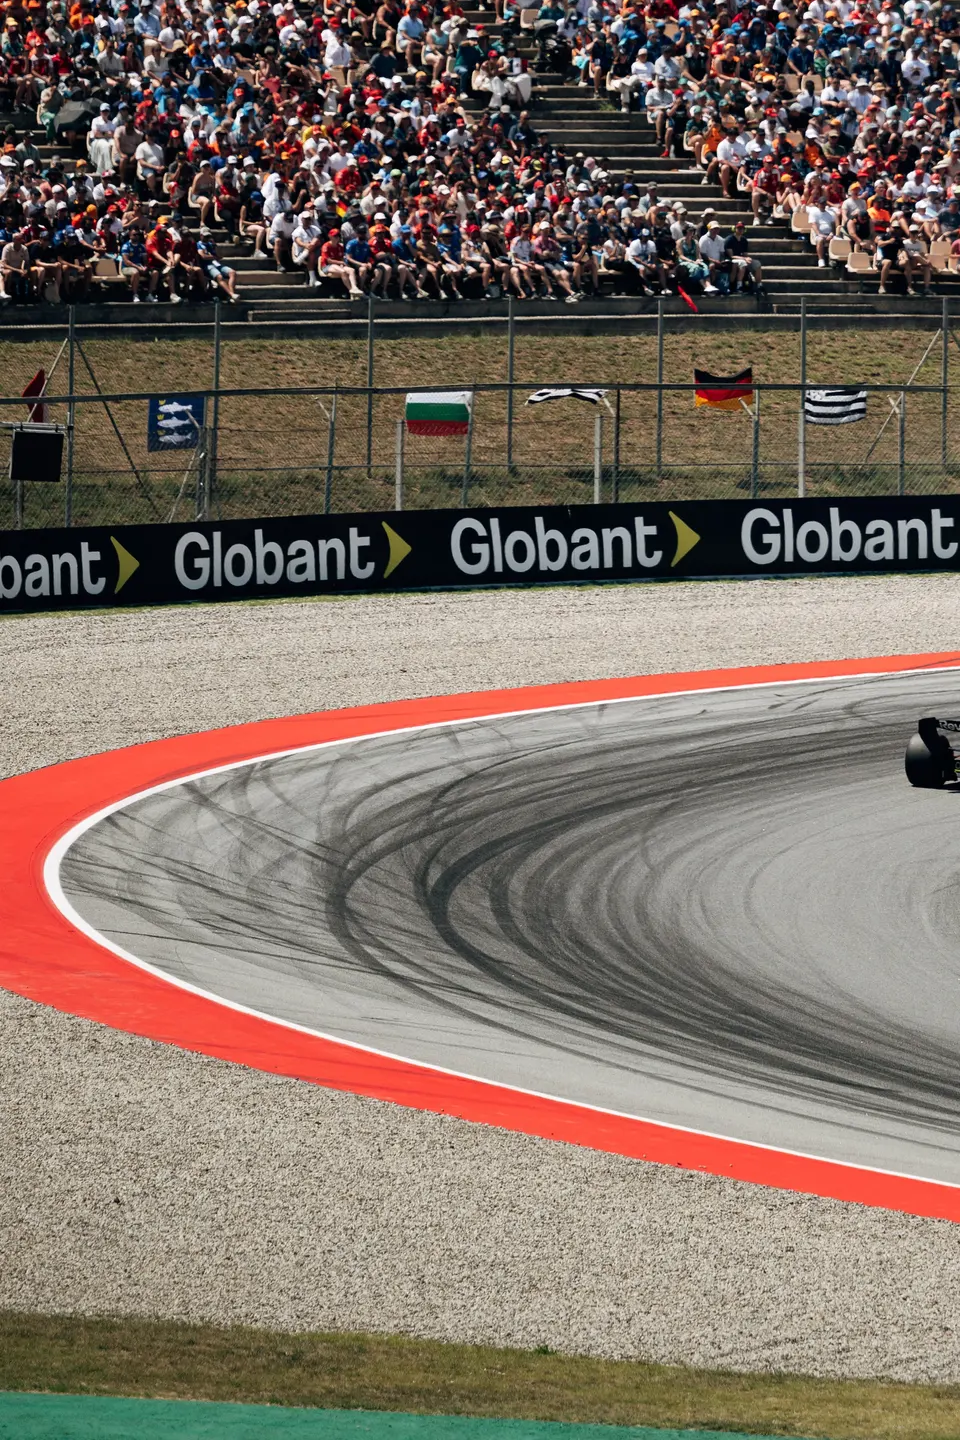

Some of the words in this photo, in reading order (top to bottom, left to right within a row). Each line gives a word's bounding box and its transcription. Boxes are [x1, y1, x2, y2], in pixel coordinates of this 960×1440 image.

[175, 528, 375, 589] Globant
[451, 517, 663, 574] Globant
[742, 507, 959, 564] Globant
